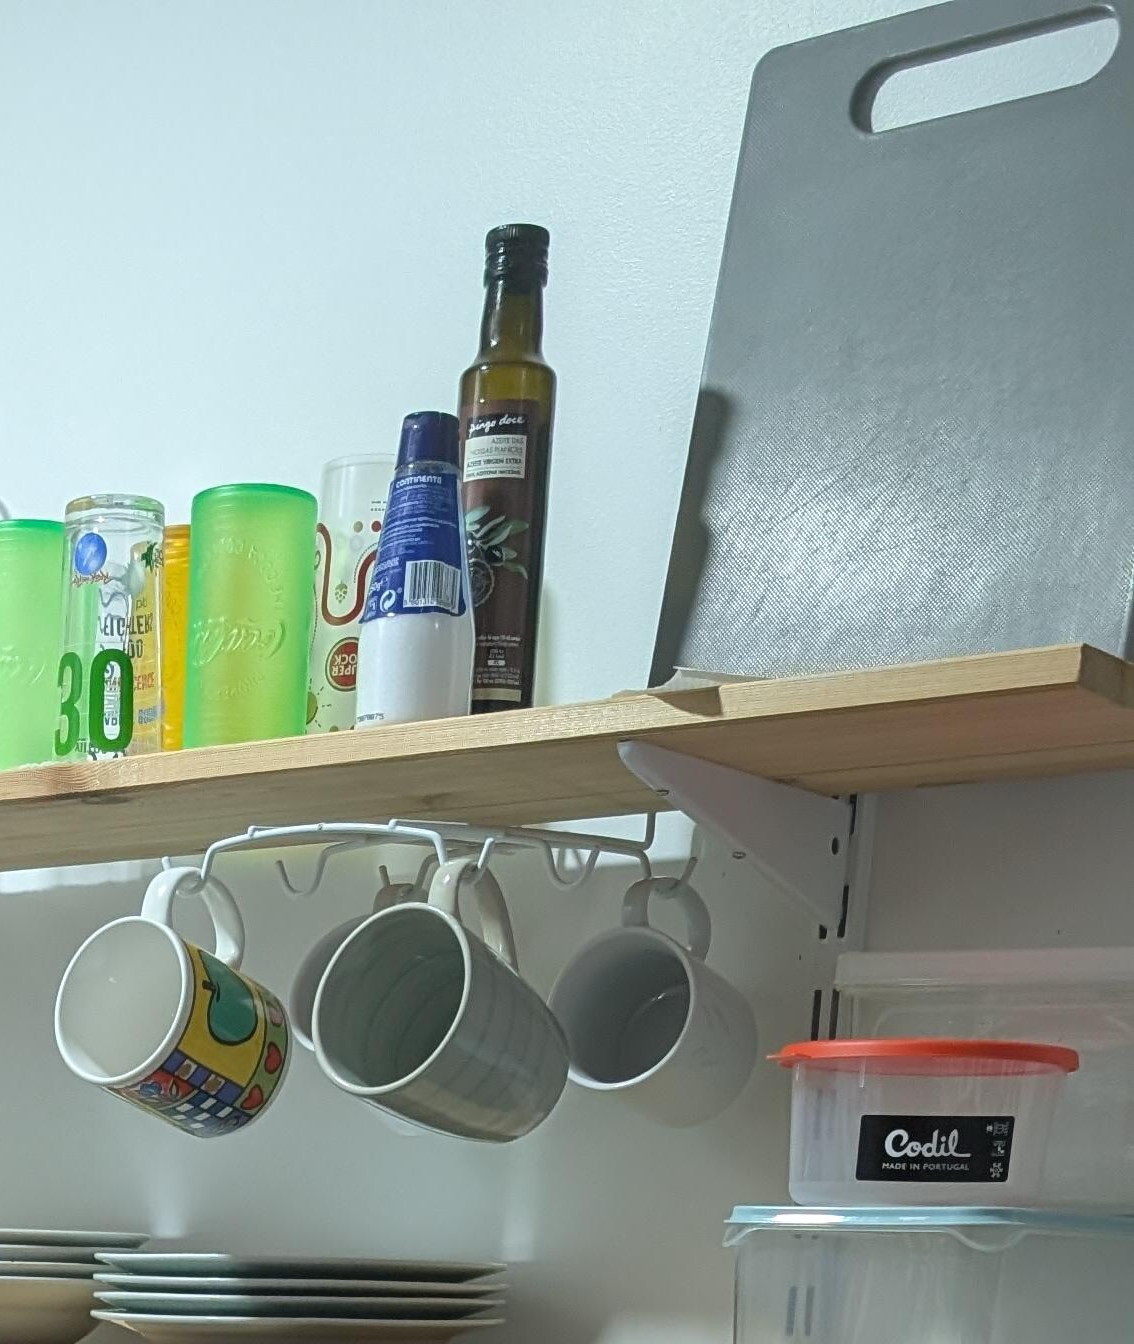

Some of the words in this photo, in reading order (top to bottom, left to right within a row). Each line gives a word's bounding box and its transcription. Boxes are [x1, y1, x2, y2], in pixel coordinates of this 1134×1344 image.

[468, 419, 496, 438] pingo
[499, 414, 525, 426] doce
[334, 654, 357, 666] OCK
[331, 665, 357, 677] UPER
[884, 1128, 971, 1158] Codil
[881, 1162, 907, 1171] MADE
[910, 1162, 921, 1171] IN
[923, 1163, 970, 1171] PORTUGAL
